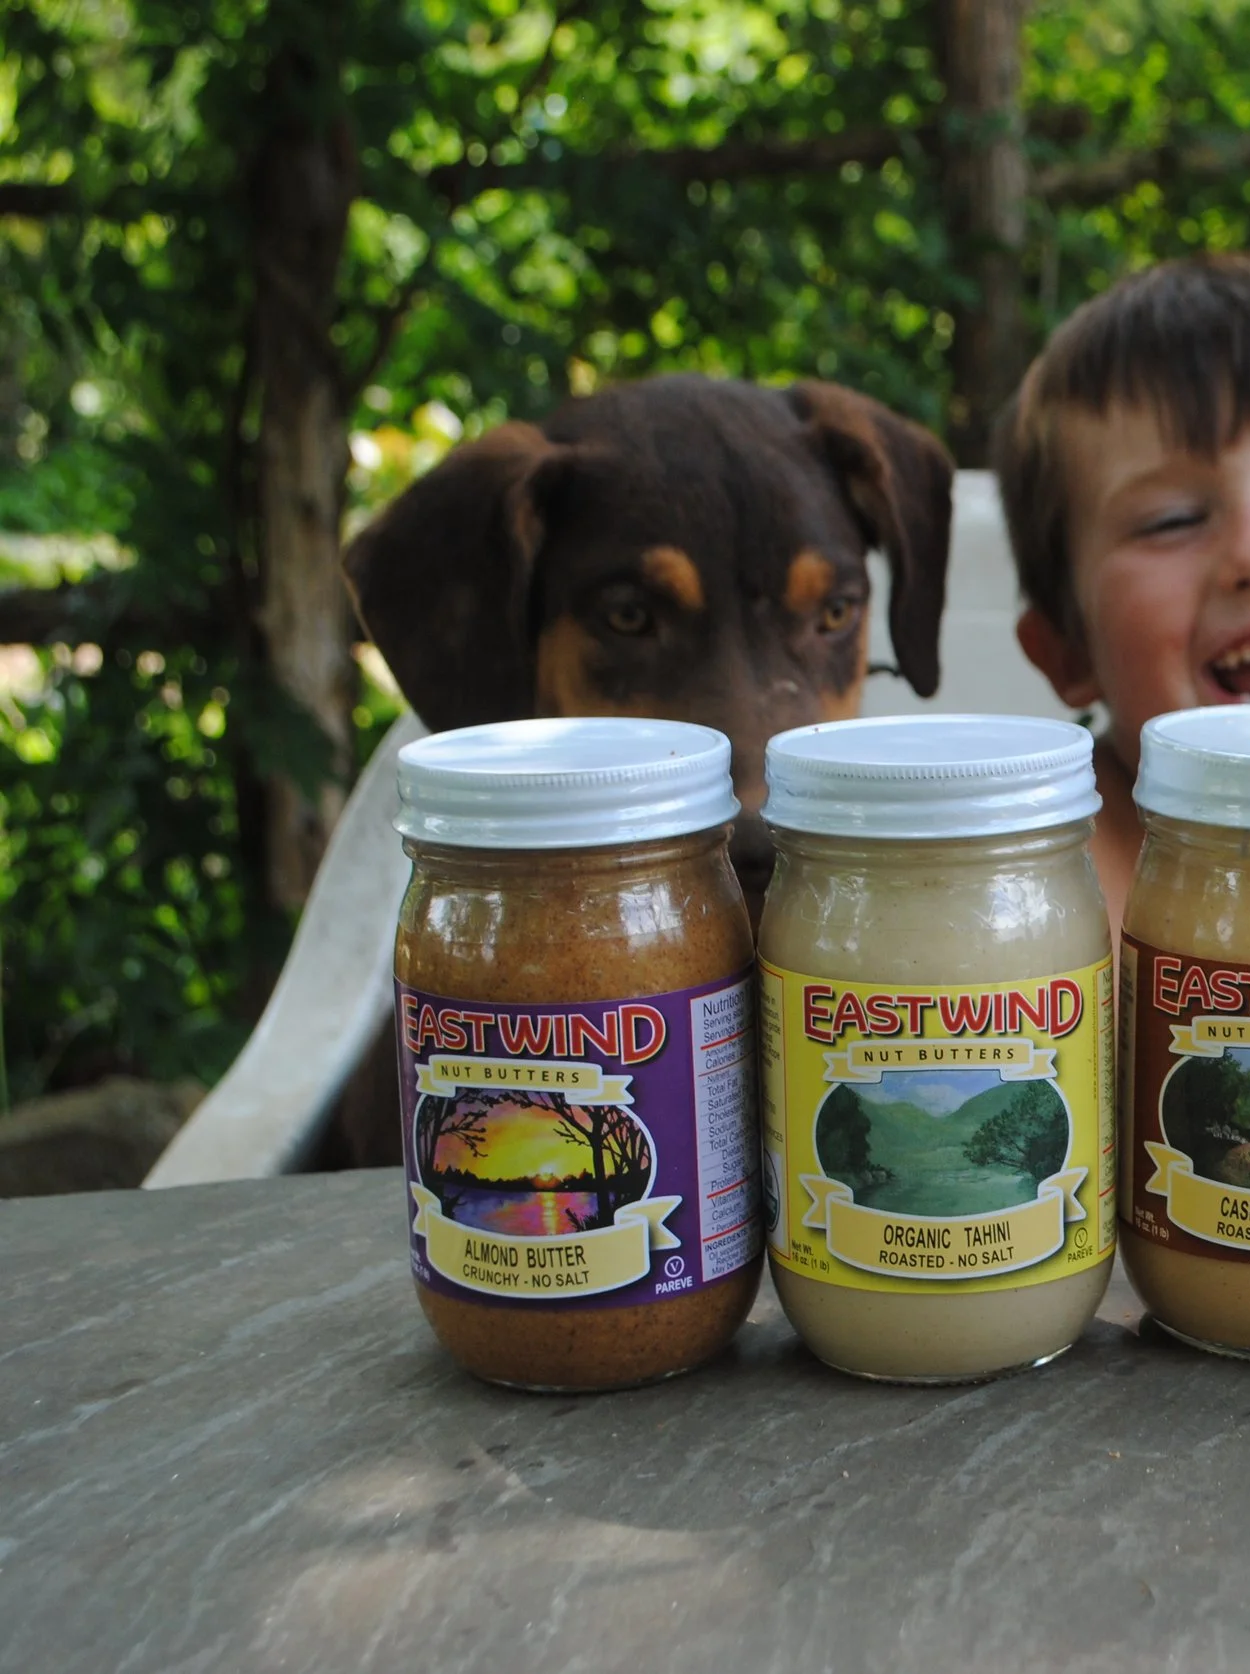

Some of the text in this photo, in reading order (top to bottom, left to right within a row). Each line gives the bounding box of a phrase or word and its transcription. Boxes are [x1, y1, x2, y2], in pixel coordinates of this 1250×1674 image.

[1208, 1026, 1246, 1039] NUT
[864, 1047, 1015, 1062] NUT BUTTERS
[441, 1064, 581, 1084] NUT BUTTERS
[883, 1221, 1011, 1249] ORGANIC TAHINI
[464, 1239, 587, 1269] ALMOND BUTTER
[879, 1249, 945, 1269] ROASTED
[958, 1253, 978, 1267] NO
[982, 1246, 1014, 1264] SALT
[1068, 1245, 1093, 1263] PAREVE
[463, 1265, 519, 1287] CRUNCHY
[531, 1274, 553, 1288] NO
[556, 1271, 590, 1287] SALT
[655, 1275, 693, 1294] PAREVE
